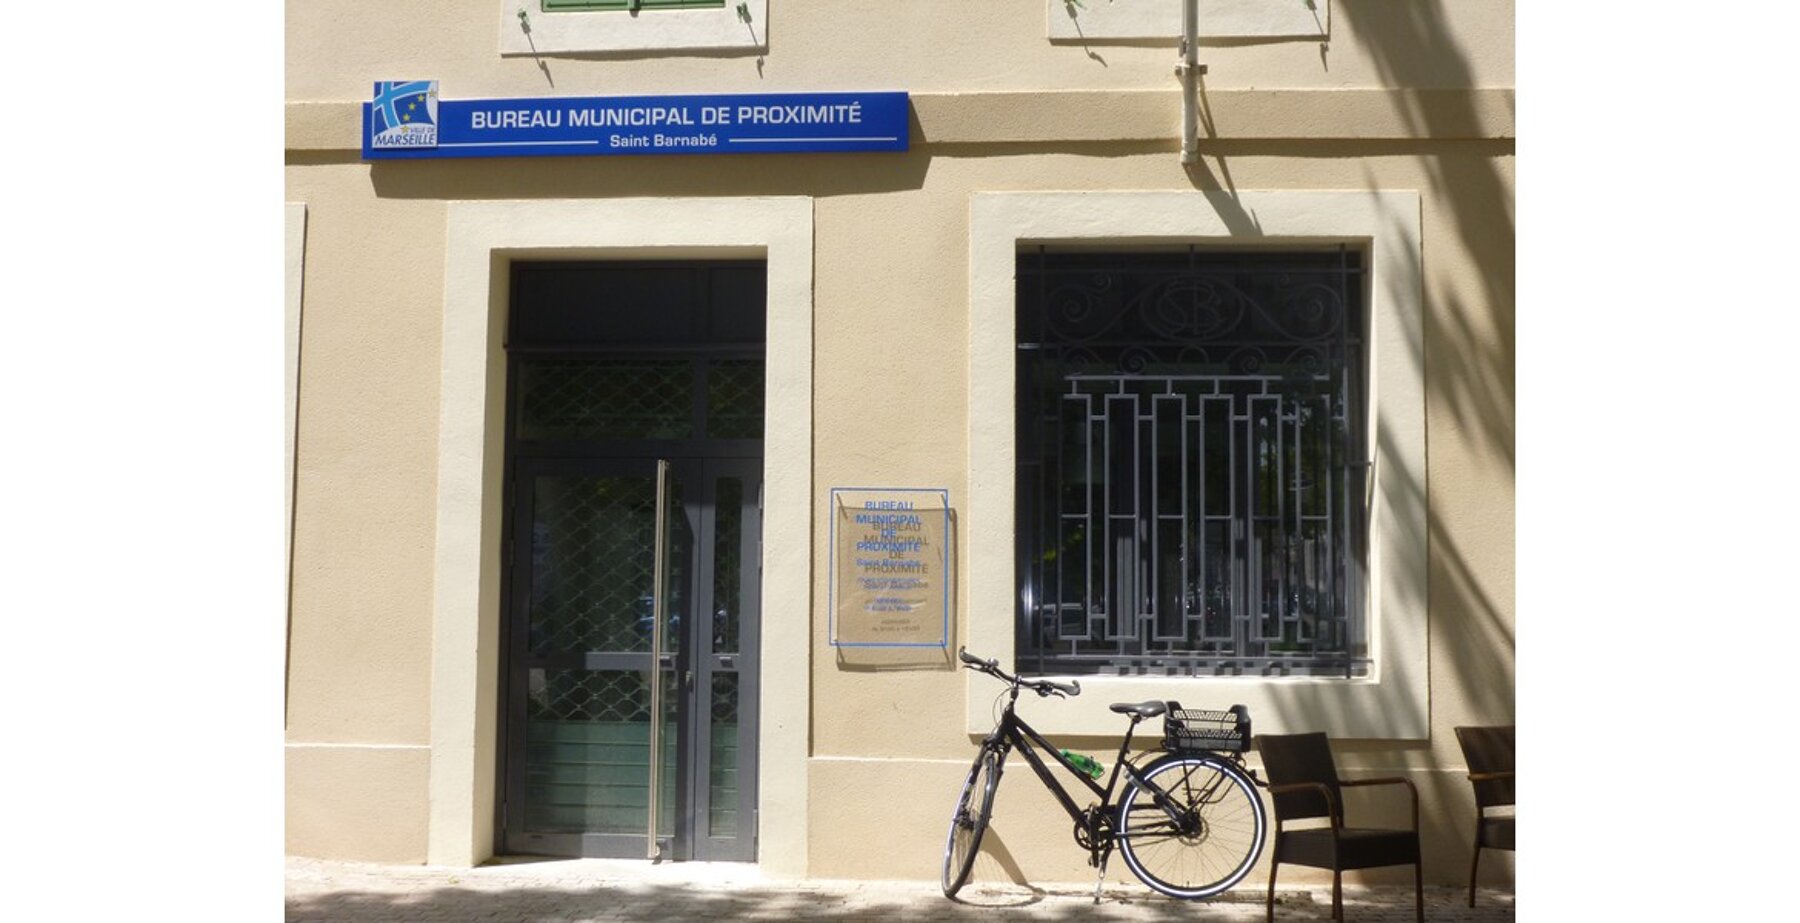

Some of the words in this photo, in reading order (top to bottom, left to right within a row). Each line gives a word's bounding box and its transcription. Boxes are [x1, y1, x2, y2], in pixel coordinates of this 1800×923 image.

[471, 110, 561, 129] BUREAU
[568, 107, 694, 127] MUNICIPAL
[701, 106, 730, 125] DE
[738, 101, 862, 124] PROXIMITÉ
[374, 133, 435, 145] MARSEILLE
[609, 134, 650, 148] Saint
[653, 133, 718, 147] Barnabé
[864, 501, 914, 511] BUREAU
[856, 514, 922, 524] MUNICIPAL
